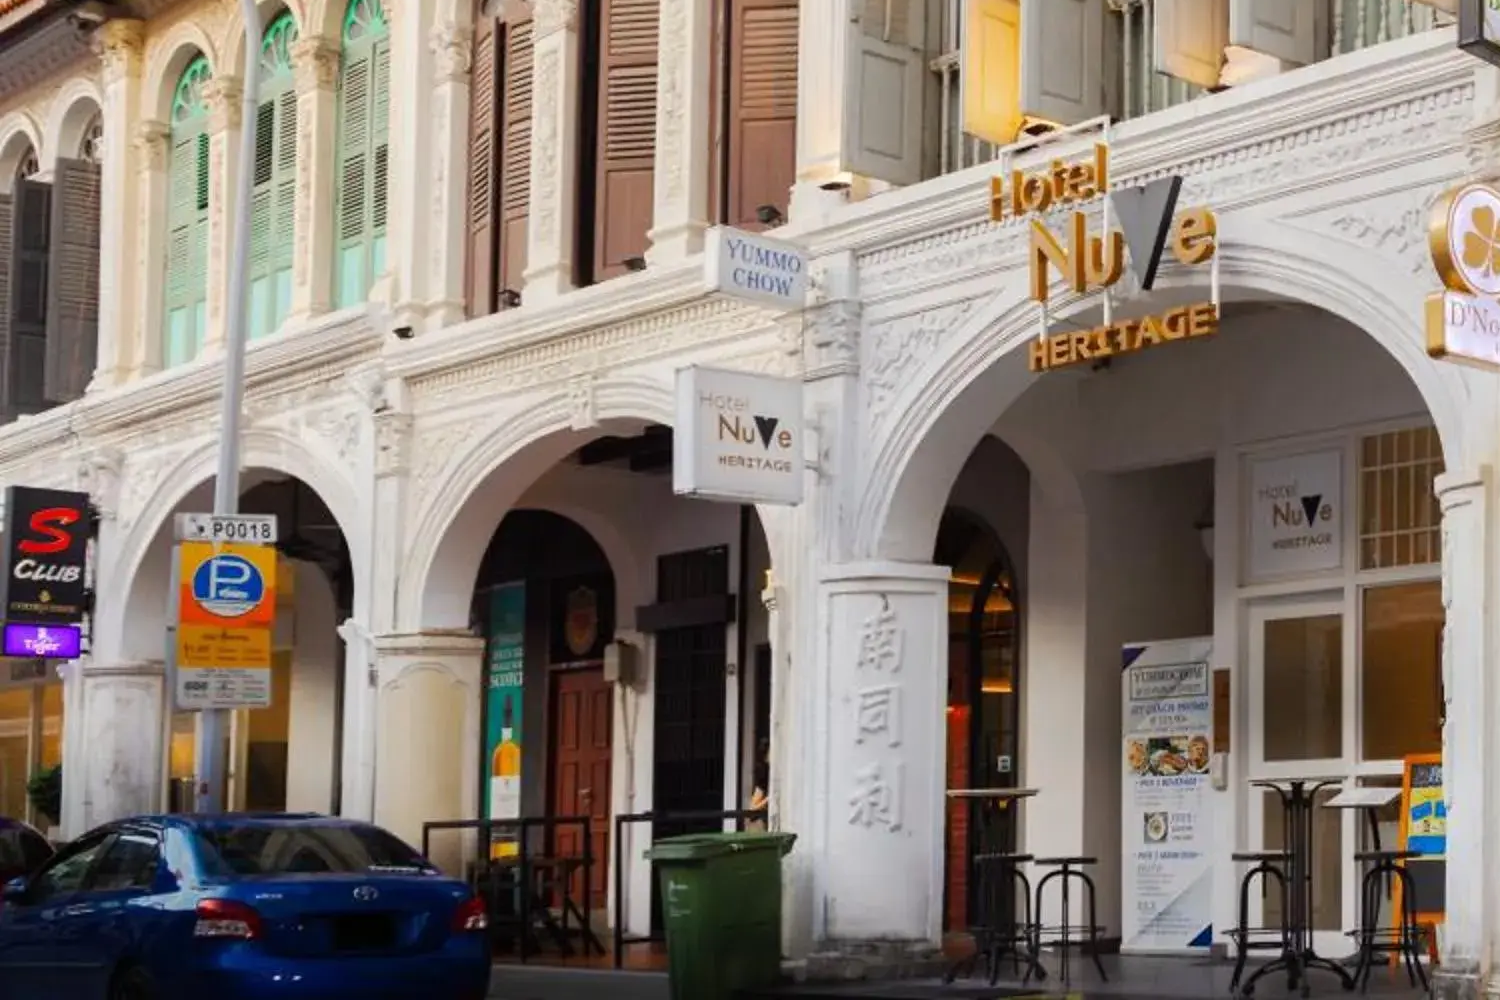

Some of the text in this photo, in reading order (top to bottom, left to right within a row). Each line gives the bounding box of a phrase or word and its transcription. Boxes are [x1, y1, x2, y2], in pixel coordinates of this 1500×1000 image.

[990, 142, 1109, 222] Hotel
[726, 239, 801, 273] YUMMO
[733, 267, 794, 297] CHOW
[1028, 301, 1219, 373] HERITAGE
[699, 388, 750, 412] Hotel
[718, 455, 792, 473] HERITAGE
[17, 507, 81, 554] S
[213, 521, 271, 539] P0018
